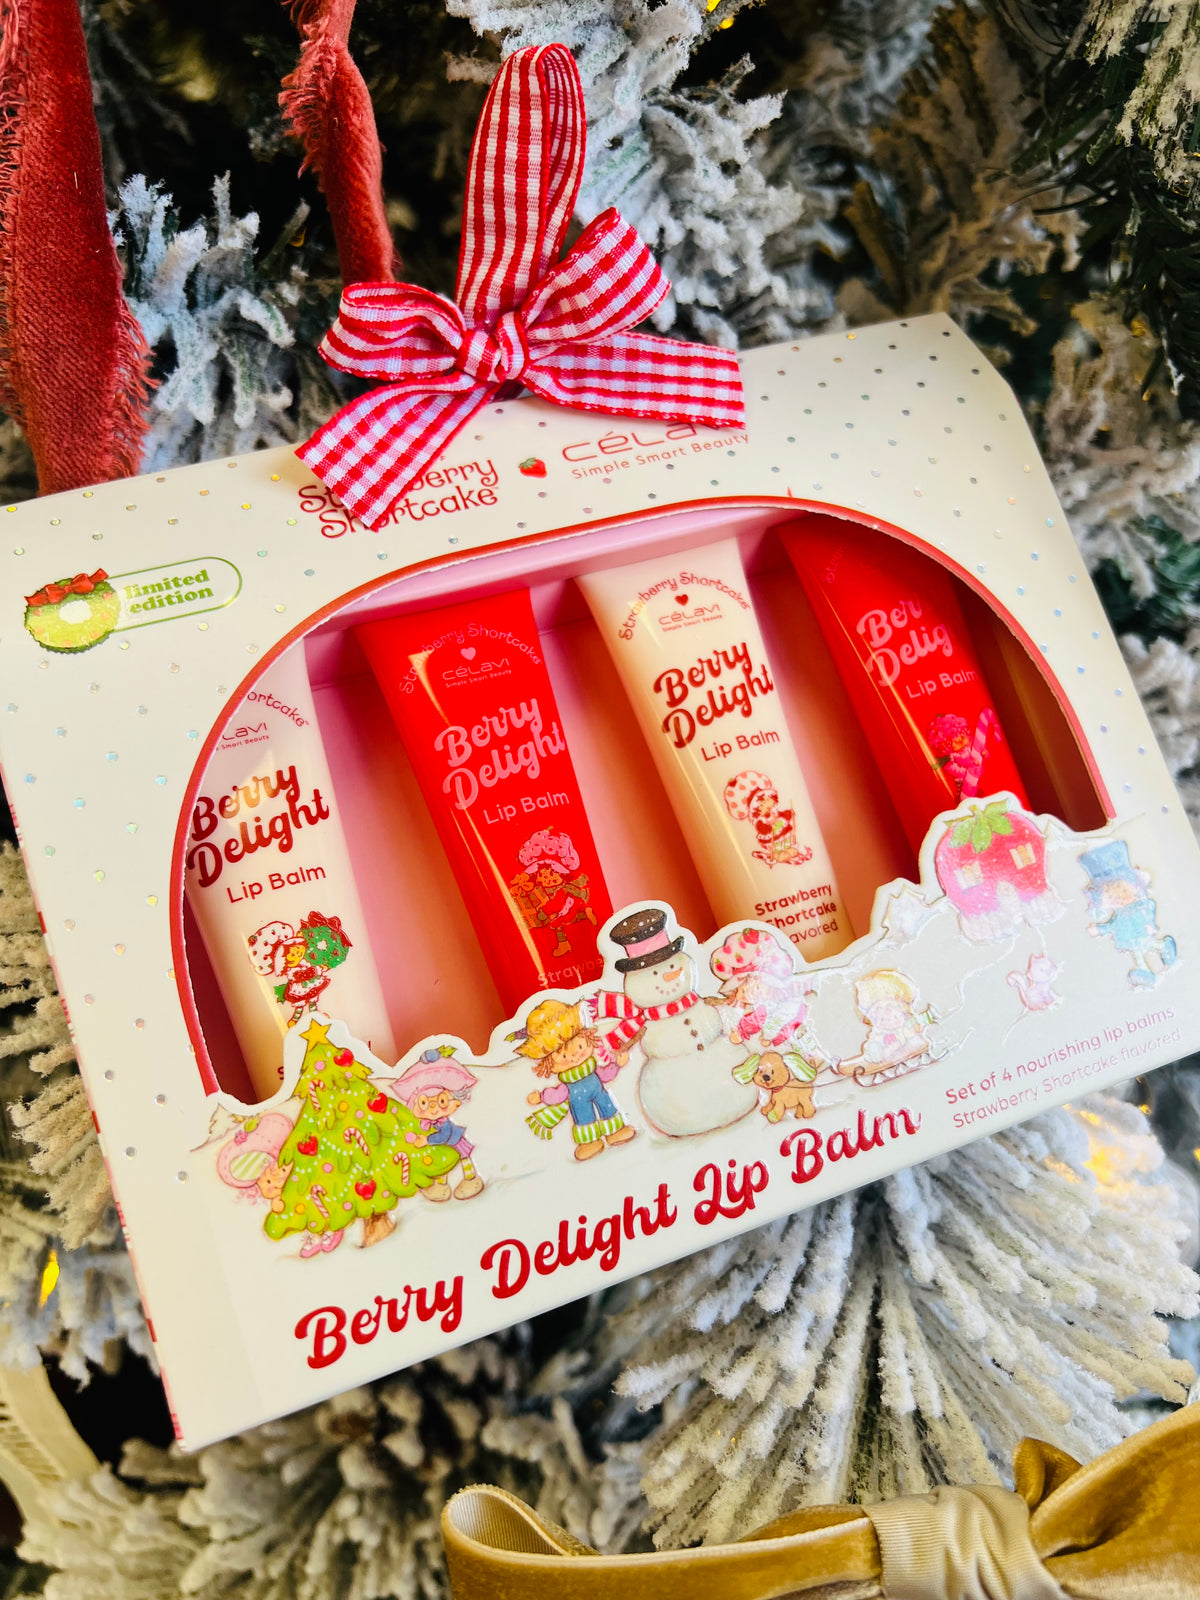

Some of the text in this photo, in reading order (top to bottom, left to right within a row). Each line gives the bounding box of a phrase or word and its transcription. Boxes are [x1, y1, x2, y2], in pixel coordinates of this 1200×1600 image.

[572, 433, 750, 480] Simple Smart Beauty
[298, 459, 499, 514] Sterry
[124, 569, 210, 600] limited
[130, 586, 215, 614] edition
[618, 571, 751, 641] Strawberry Shortcake
[856, 594, 922, 649] Ber
[399, 623, 543, 694] Strawberry Shortcake
[652, 641, 752, 708] Berry
[865, 623, 954, 688] Delig
[247, 691, 305, 727] ortcake
[662, 664, 775, 749] Delight
[905, 668, 978, 699] Lip Balm
[434, 698, 543, 768] Berry
[701, 727, 781, 762] Lip Balm
[442, 721, 566, 810] Delight
[191, 765, 301, 841] Berry
[483, 790, 570, 825] Lip Balm
[186, 788, 330, 888] Delight
[226, 866, 327, 904] Lip Balm
[754, 882, 833, 916] Strawberry
[789, 918, 839, 944] avored
[537, 958, 603, 987] Strawbe
[945, 1007, 1175, 1105] Set of 4 nourishing lip balms
[952, 1027, 1183, 1129] Strawberry Shortcake flavored
[295, 1106, 922, 1370] Berry Delight Lip Balm
